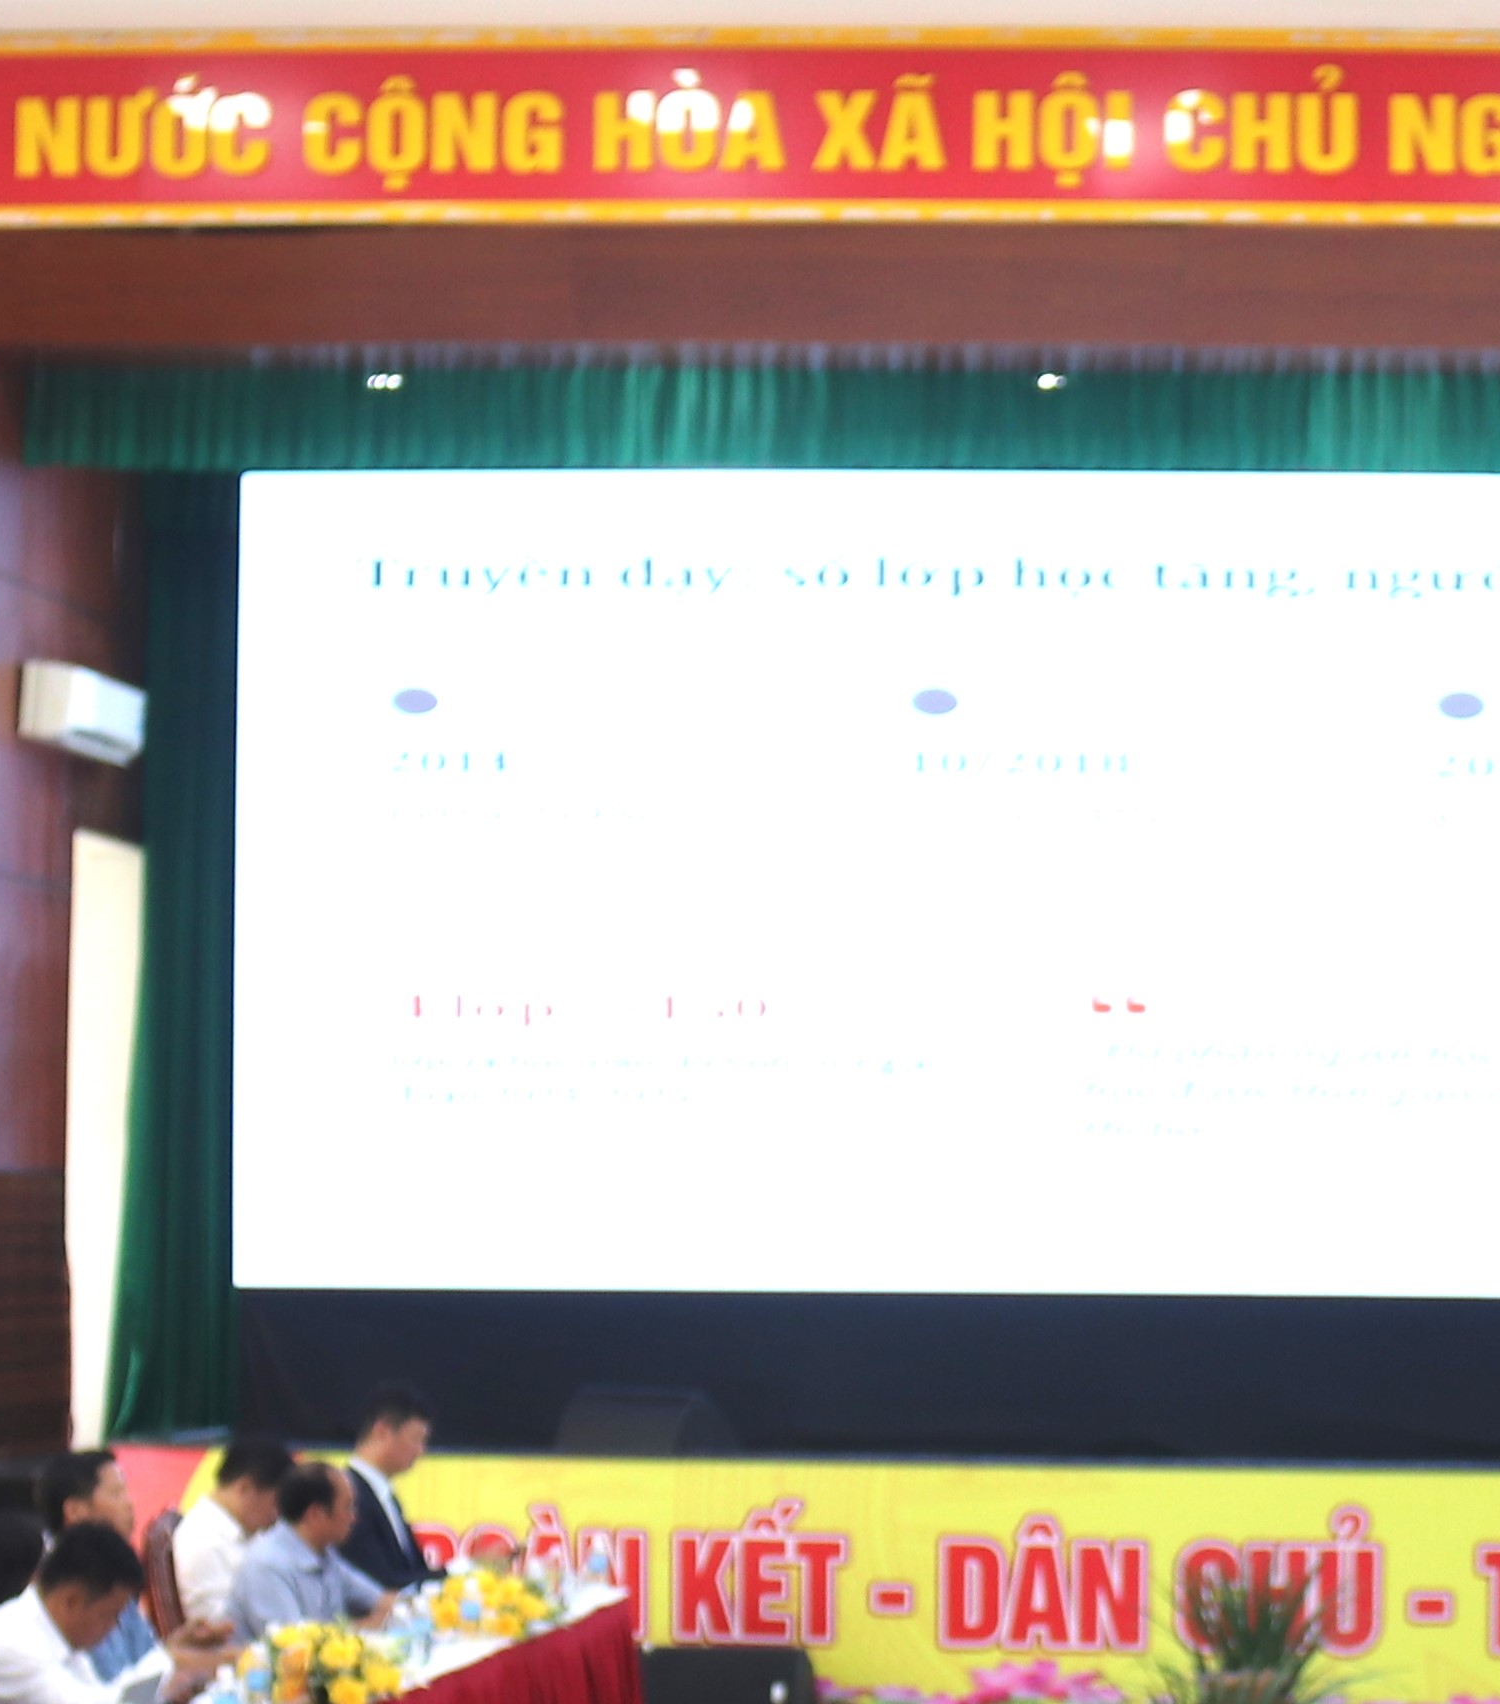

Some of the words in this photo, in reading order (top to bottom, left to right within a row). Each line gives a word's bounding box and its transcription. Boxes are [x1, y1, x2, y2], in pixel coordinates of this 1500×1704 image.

[14, 73, 273, 179] NƯỚC
[302, 76, 563, 188] CỘNG
[594, 68, 785, 175] HÒA
[813, 73, 945, 172] XÃ
[971, 70, 1134, 188] HỘI
[1163, 64, 1359, 176] CHỦ
[671, 1496, 848, 1647] KẾT
[937, 1512, 1148, 1652] DÂN
